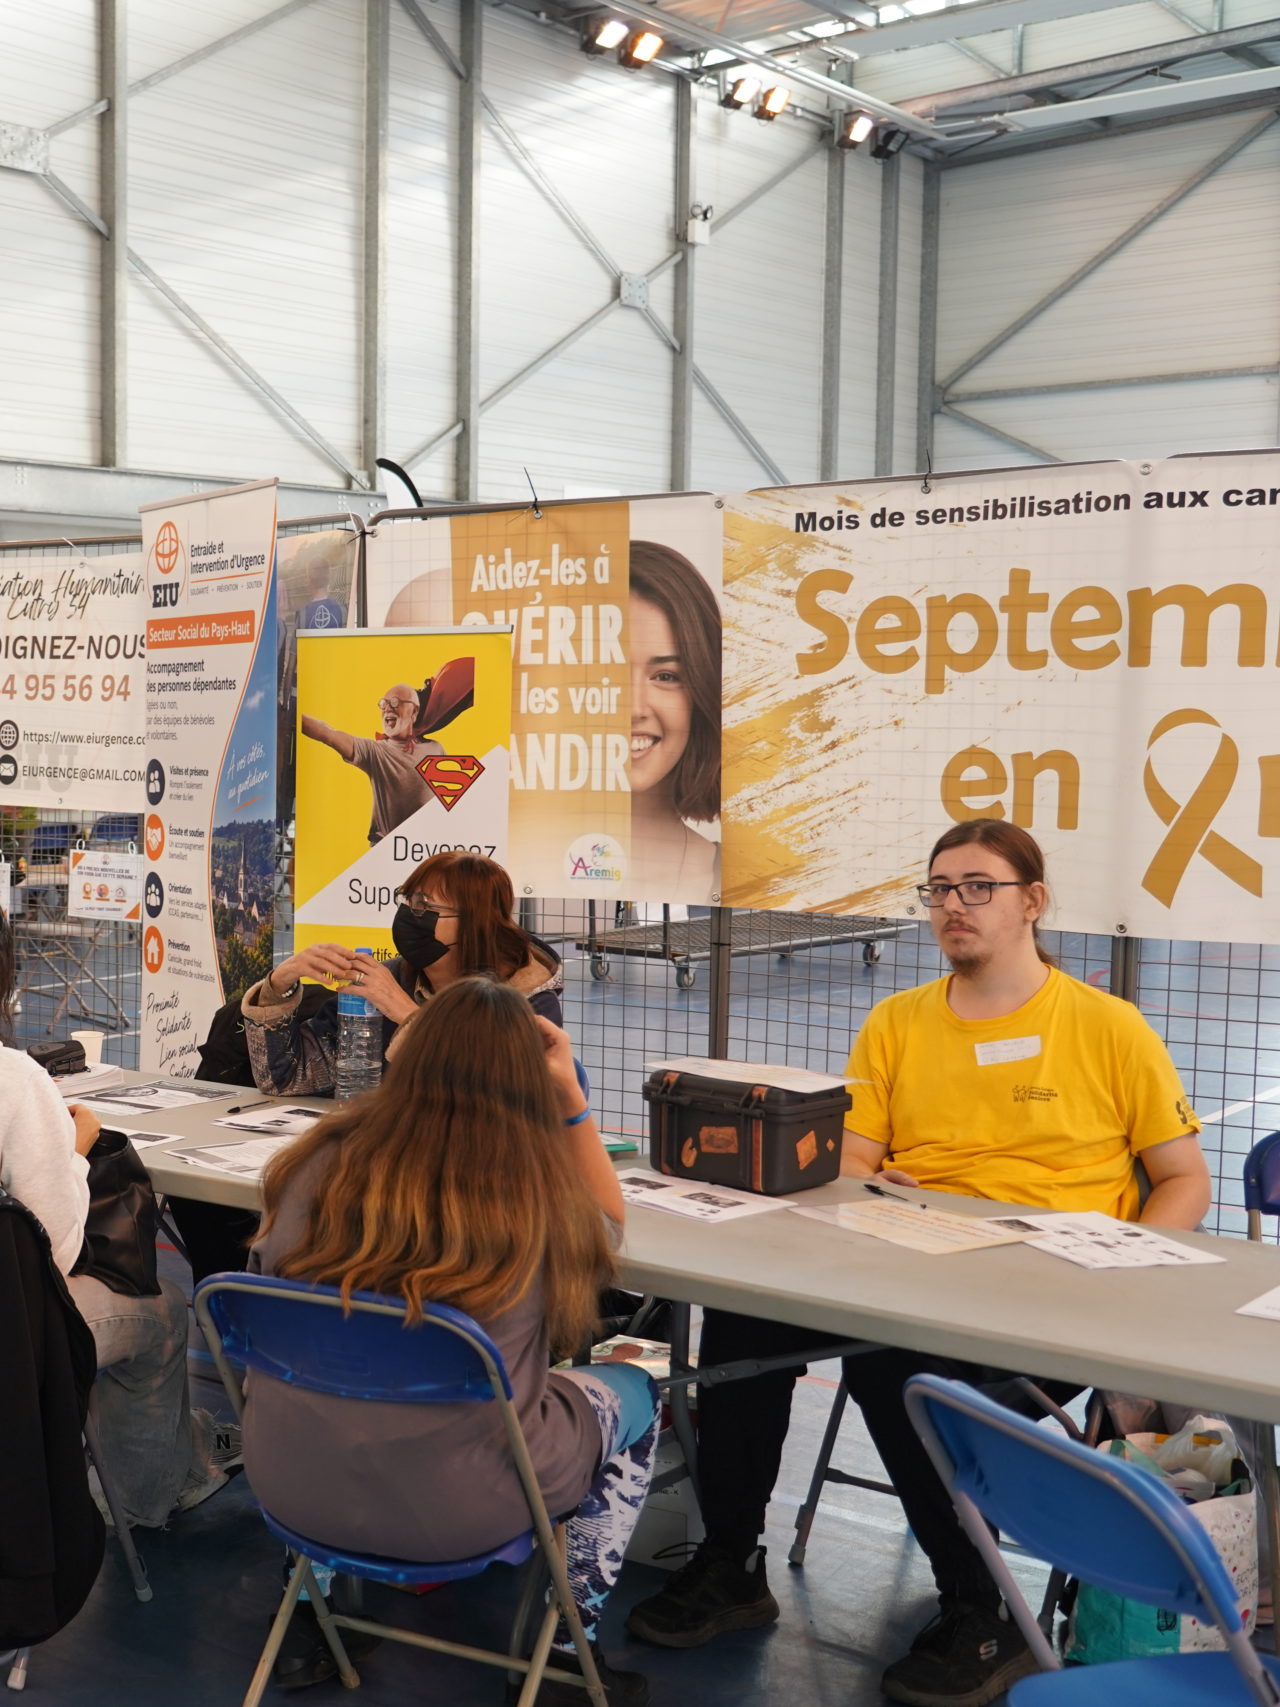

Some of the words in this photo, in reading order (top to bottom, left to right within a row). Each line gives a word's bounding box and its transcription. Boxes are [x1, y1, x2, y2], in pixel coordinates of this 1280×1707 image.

[794, 509, 860, 533] Mois
[870, 506, 905, 529] de
[914, 489, 1131, 526] sensibilisation
[1142, 489, 1209, 510] aux
[190, 541, 216, 558] Entraide
[218, 540, 224, 554] et
[190, 557, 229, 574] Intervention
[230, 554, 265, 571] d'Urgence
[470, 543, 587, 593] Aidez-les
[593, 544, 610, 584] à
[51, 568, 145, 599] Humanitair
[152, 582, 180, 608] EIU
[149, 628, 176, 642] Secteur
[177, 623, 199, 640] Social
[200, 623, 210, 639] du
[211, 620, 250, 640] Pays-Haut
[461, 592, 627, 665] ÉRIR
[794, 567, 1280, 695] Septem
[146, 659, 205, 676] Accompagnement
[24, 675, 56, 701] 95
[62, 675, 93, 702] 56
[100, 675, 131, 702] 94
[157, 680, 192, 695] personnes
[192, 676, 237, 694] dépendantes
[520, 672, 559, 715] les
[569, 672, 621, 715] voir
[190, 713, 215, 725] bénévoles
[22, 765, 146, 782] EIURGENCE@GMAIL.COM
[169, 765, 184, 776] Visites
[189, 766, 209, 778] présence
[508, 733, 632, 792] ANDIR
[939, 745, 1080, 831] en
[169, 823, 184, 836] Écoute
[189, 827, 205, 838] soutien
[570, 856, 622, 881] Aremig
[168, 882, 192, 895] Orientation
[168, 939, 191, 952] Prévention
[146, 990, 180, 1022] Proximité
[156, 1012, 192, 1043] Solidarité
[159, 1042, 177, 1068] Lien
[178, 1033, 198, 1058] social
[216, 1433, 231, 1449] N
[979, 1639, 998, 1660] S
